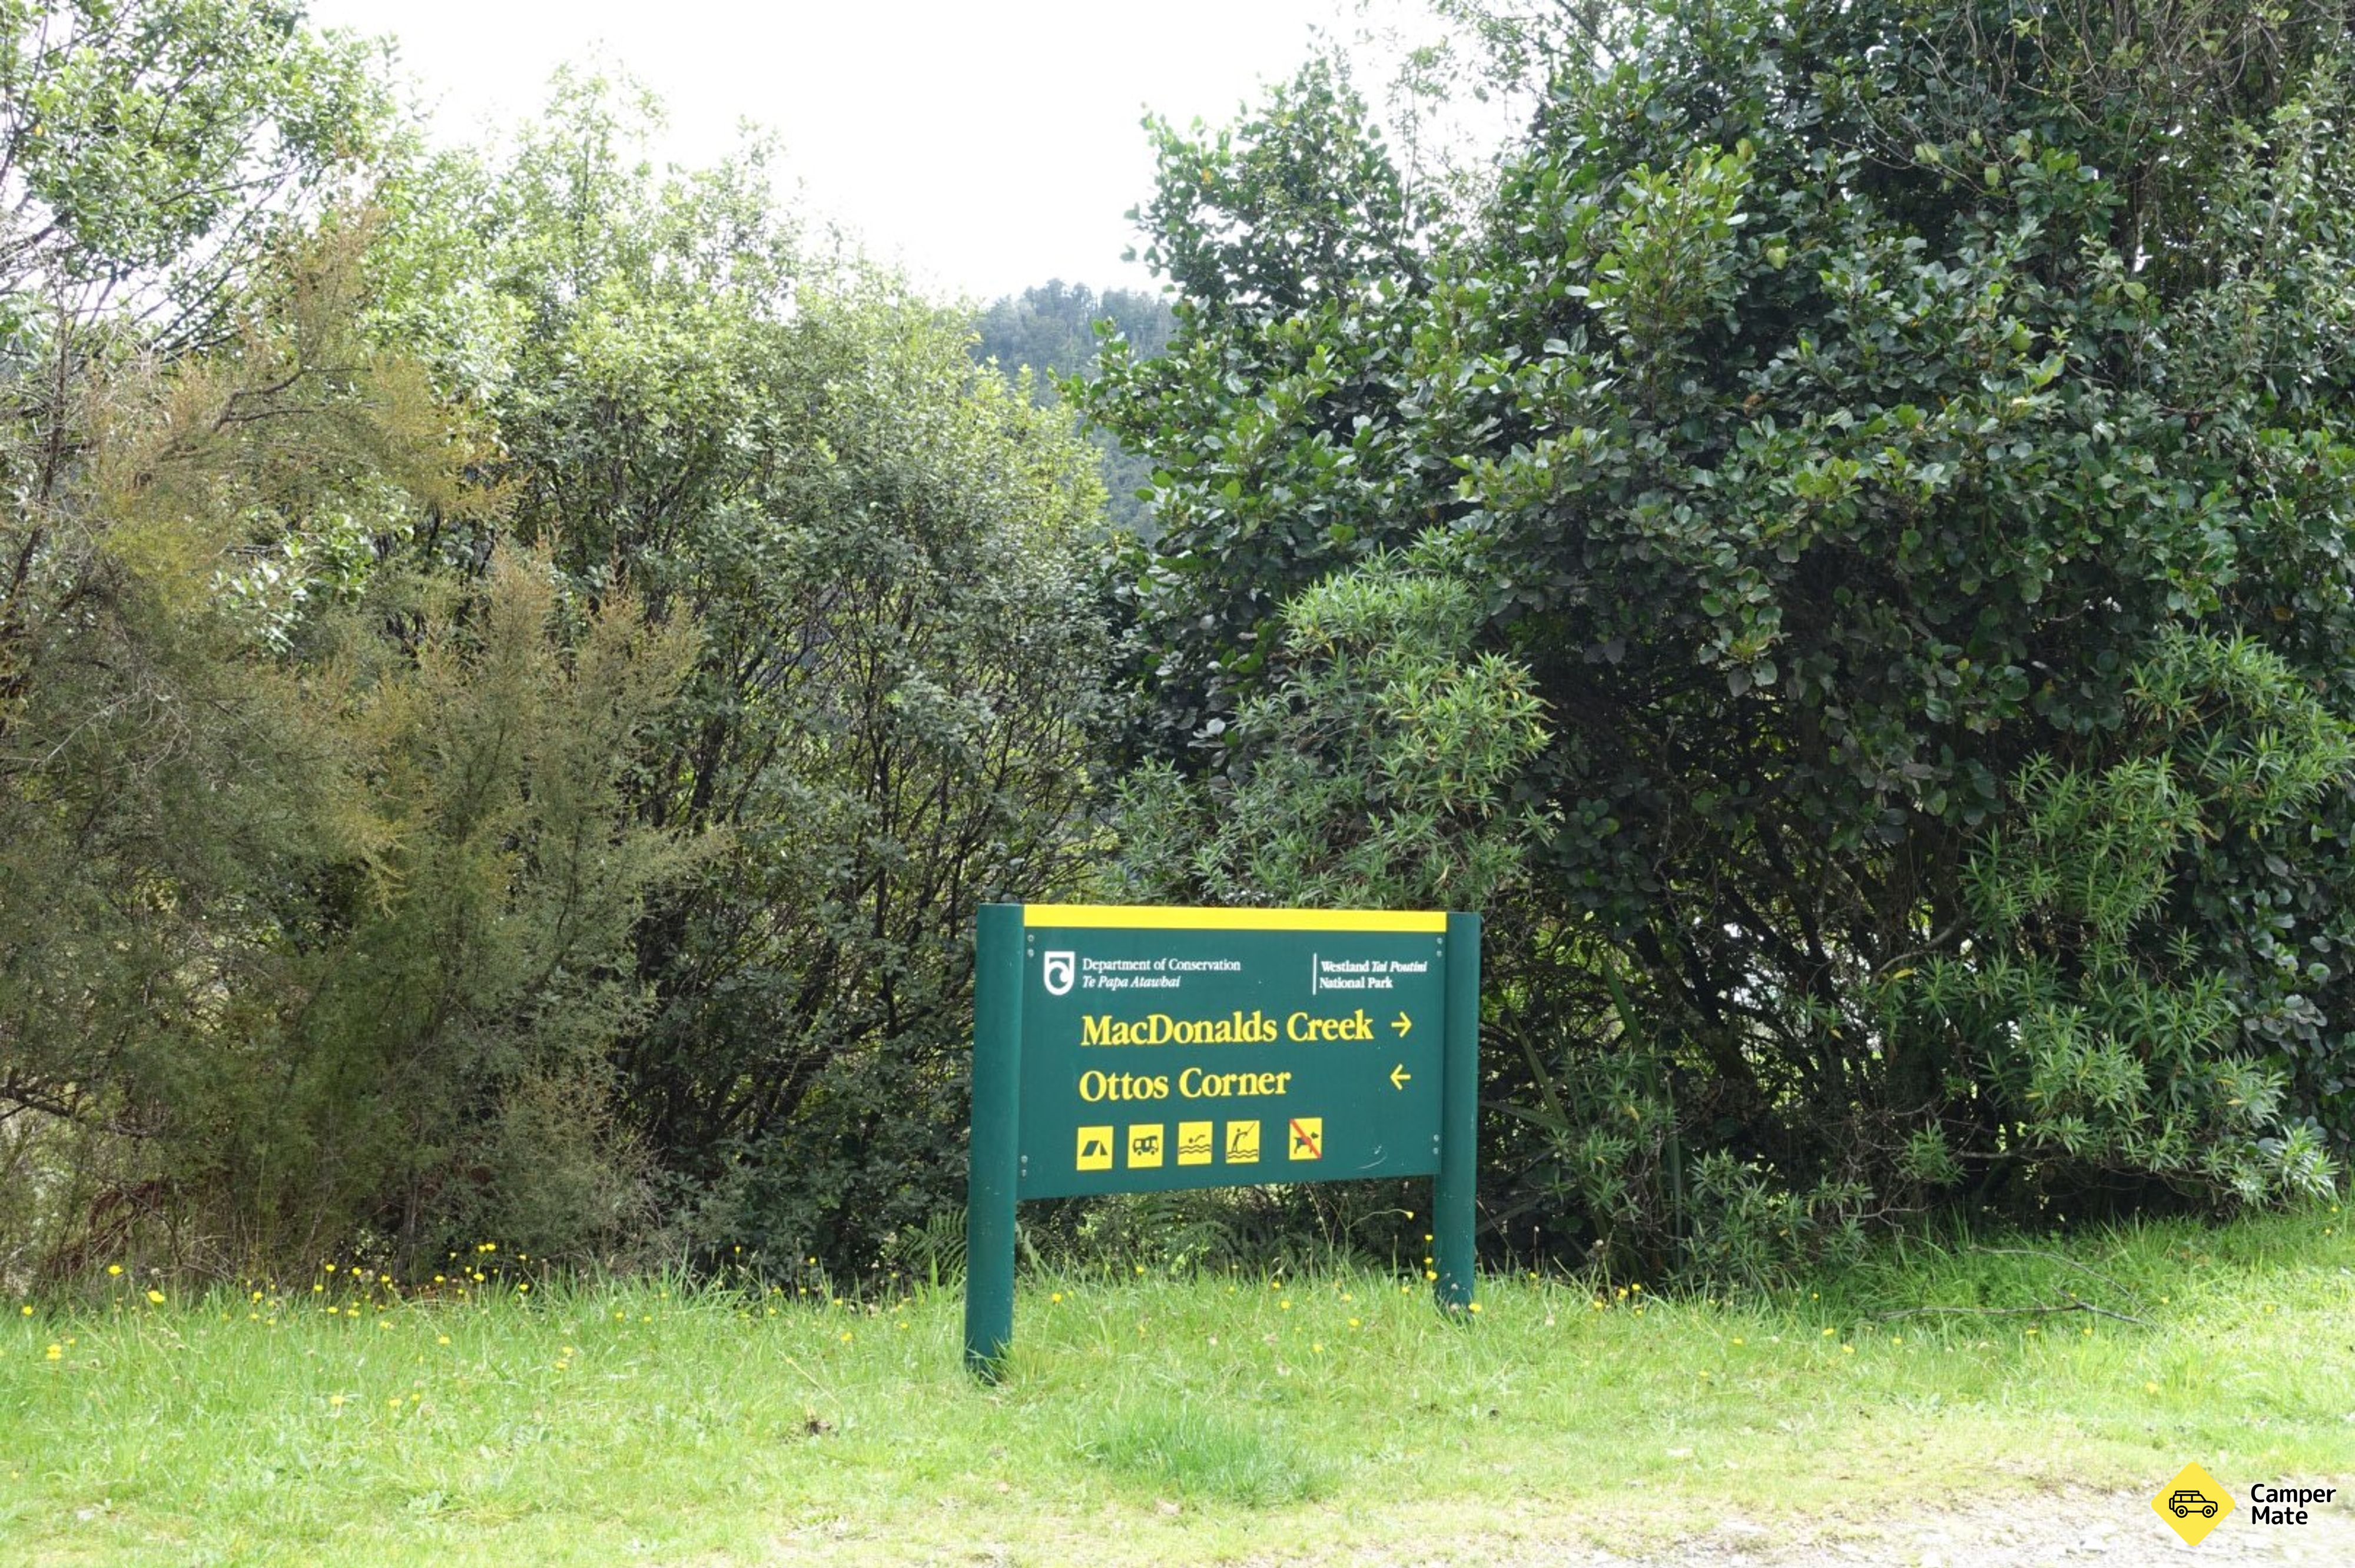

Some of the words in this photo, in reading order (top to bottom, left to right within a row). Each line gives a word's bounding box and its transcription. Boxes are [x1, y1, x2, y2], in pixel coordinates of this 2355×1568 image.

[1082, 958, 1150, 973] Department
[1153, 958, 1167, 971] of
[1168, 958, 1240, 971] Conservation
[1321, 959, 1369, 972] Westland
[1371, 961, 1388, 972] Tai
[1389, 961, 1428, 972] Poutini
[1082, 975, 1095, 988] Te
[1097, 975, 1129, 991] Papa
[1130, 975, 1181, 988] Atawhai
[1319, 975, 1365, 988] National
[1367, 975, 1394, 988] Park
[1080, 1010, 1278, 1047] MacDonalds
[1286, 1009, 1374, 1042] Creek
[1079, 1070, 1170, 1102] Ottos
[1178, 1067, 1292, 1098] Corner
